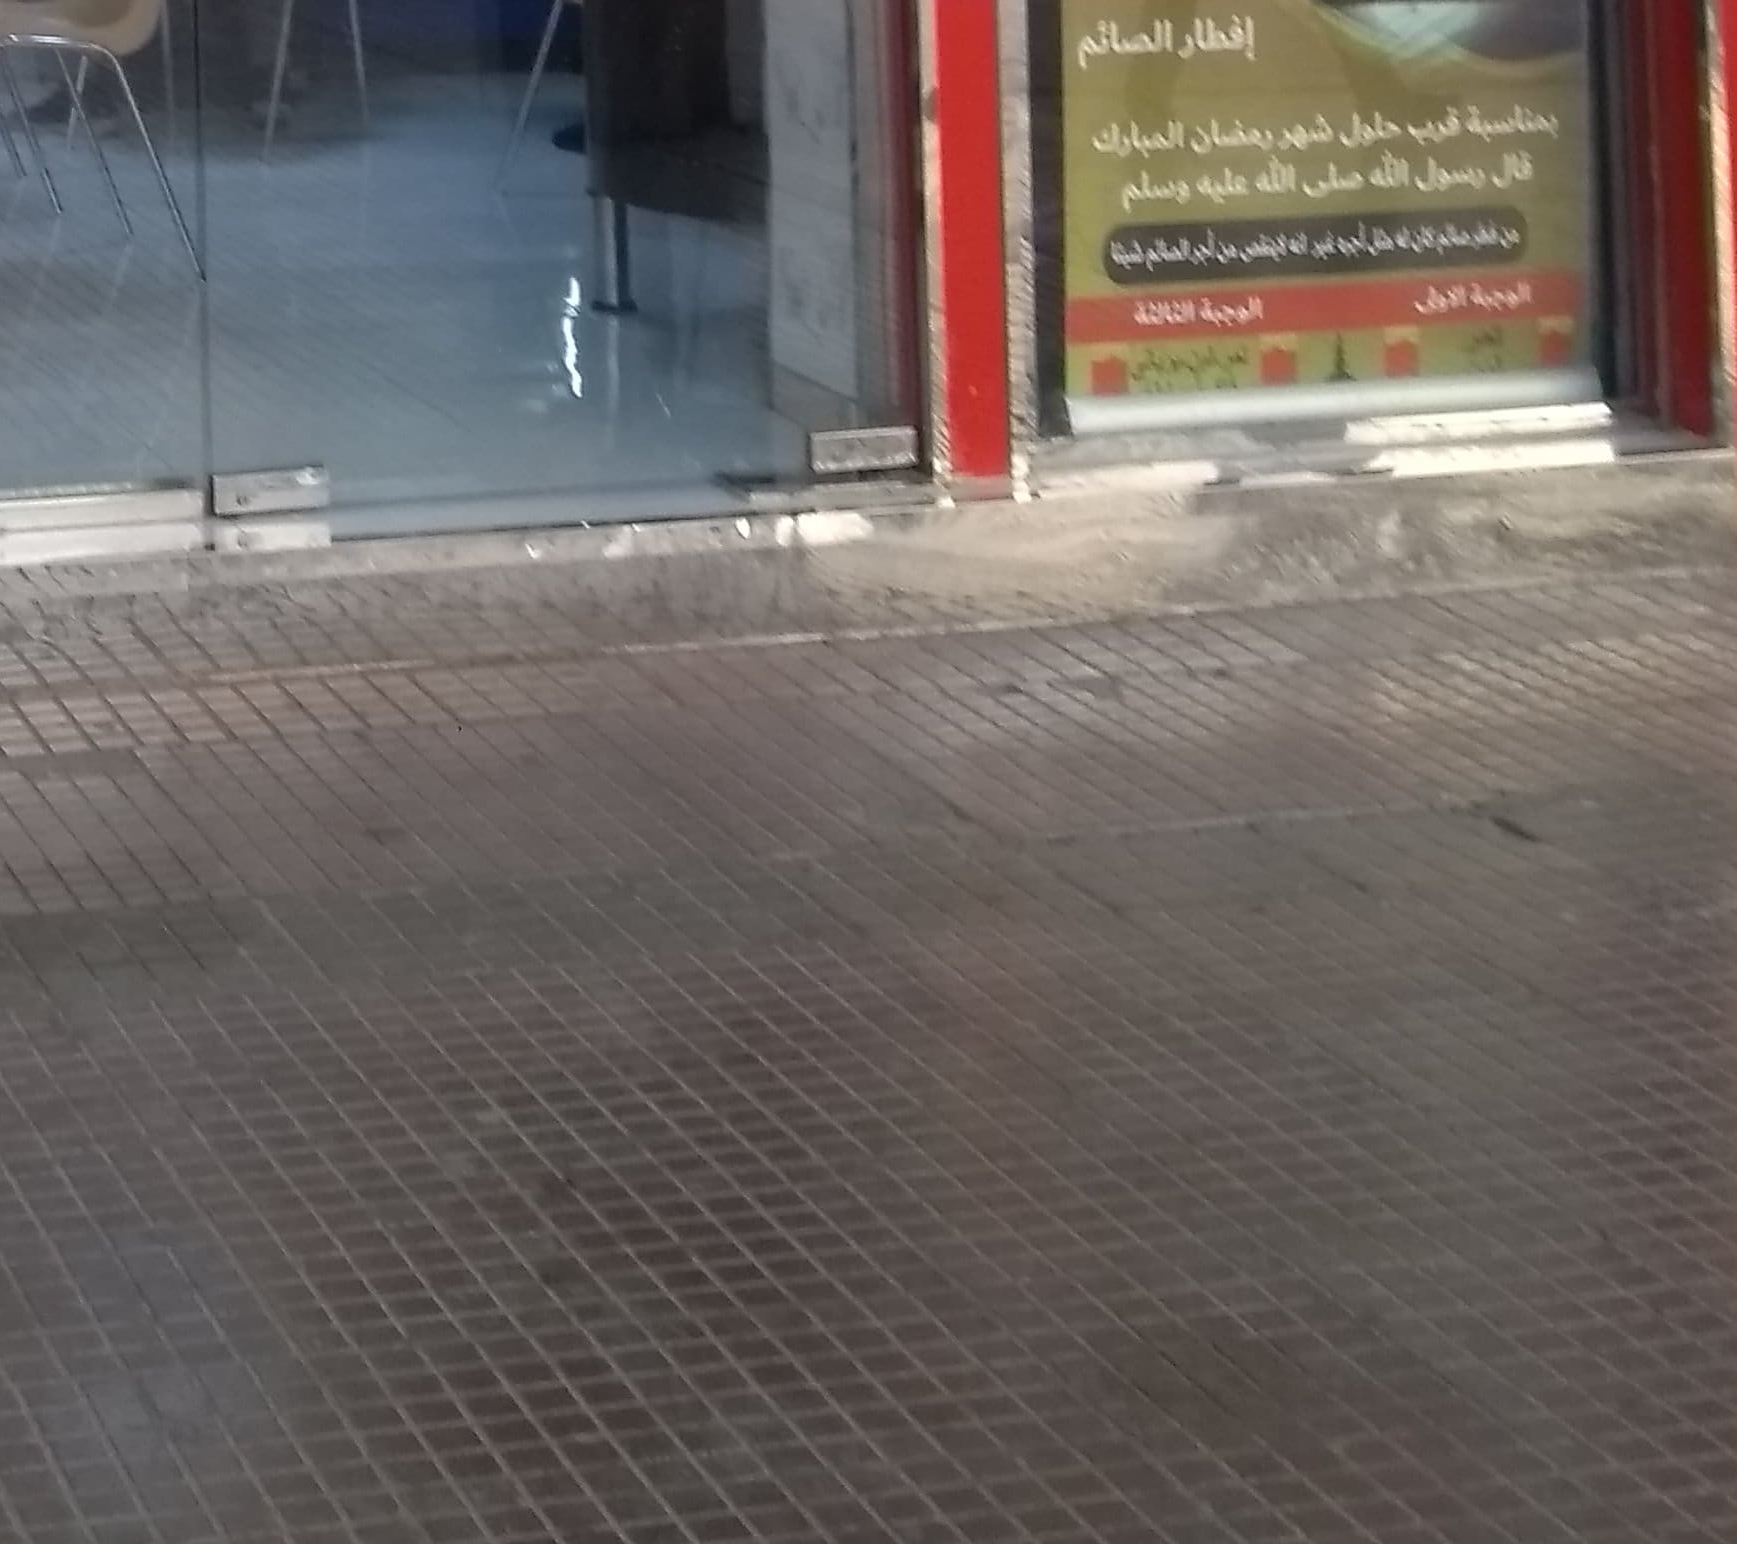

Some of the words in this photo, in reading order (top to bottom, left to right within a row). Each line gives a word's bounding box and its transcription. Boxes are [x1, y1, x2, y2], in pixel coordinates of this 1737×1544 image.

[1078, 18, 1173, 69] الصائم
[1178, 14, 1255, 61] إفطار
[1092, 120, 1184, 158] المبارك
[1190, 119, 1272, 155] رمضان
[1278, 113, 1334, 151] شهر
[1339, 112, 1401, 148] حلول
[1407, 107, 1460, 146] قرب
[1466, 105, 1559, 138] بمناسبة
[1196, 167, 1249, 203] عليه
[1255, 155, 1296, 194] الله
[1303, 162, 1363, 197] صلى
[1370, 150, 1409, 187] الله
[1414, 156, 1486, 192] رسول
[1492, 150, 1533, 188] قال
[1122, 171, 1190, 213] وسلم
[1199, 296, 1263, 328] الوجبة
[1470, 280, 1534, 311] الوجبة
